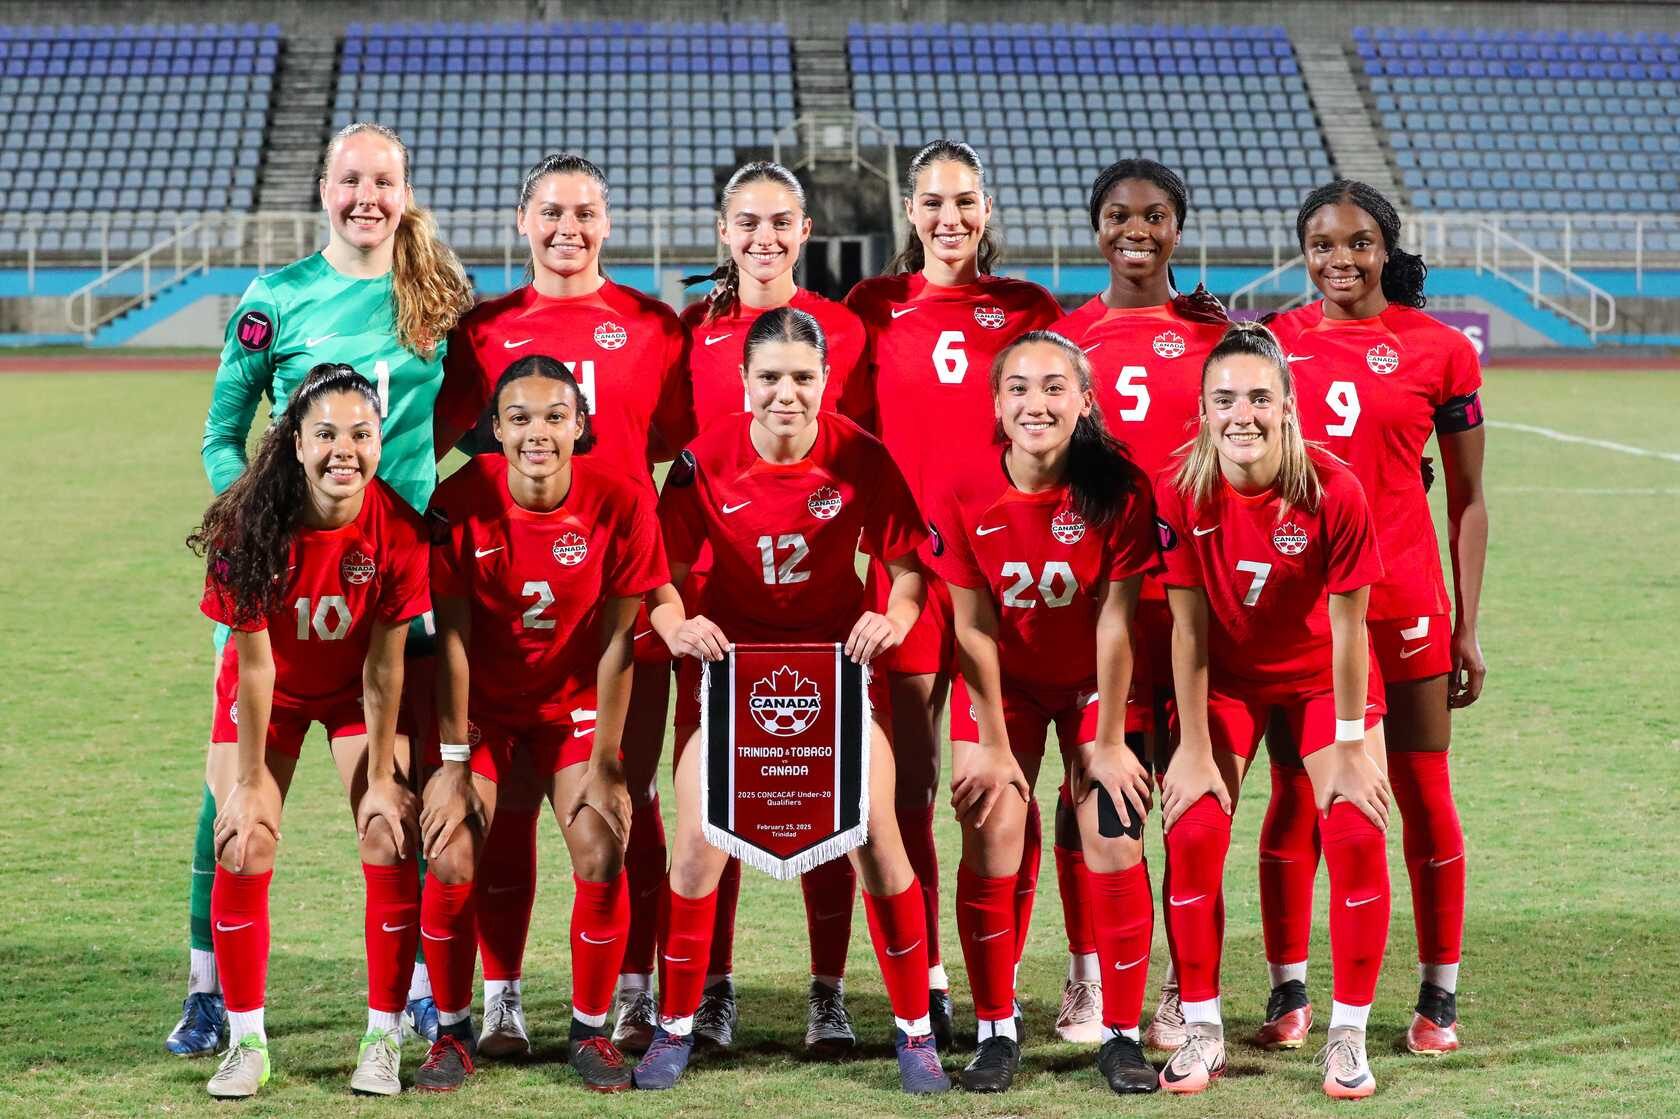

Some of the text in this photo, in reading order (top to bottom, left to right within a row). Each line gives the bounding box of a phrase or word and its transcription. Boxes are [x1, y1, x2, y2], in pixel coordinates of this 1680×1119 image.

[931, 330, 969, 384] 6
[1367, 355, 1398, 364] CANADA
[1114, 365, 1152, 422] 5
[1324, 380, 1362, 437] 9
[809, 498, 841, 508] CANADA
[1052, 523, 1085, 532] CANADA
[553, 544, 586, 554] CANADA
[755, 533, 812, 585] 12
[1000, 561, 1080, 609] 20
[1235, 560, 1272, 607] 7
[294, 595, 351, 641] 10
[520, 580, 556, 630] 2
[750, 698, 820, 709] CANADA
[738, 747, 832, 757] TRINIDAD & TOBAGO
[760, 765, 809, 776] CANADA
[756, 824, 785, 832] February
[785, 824, 795, 832] 25,
